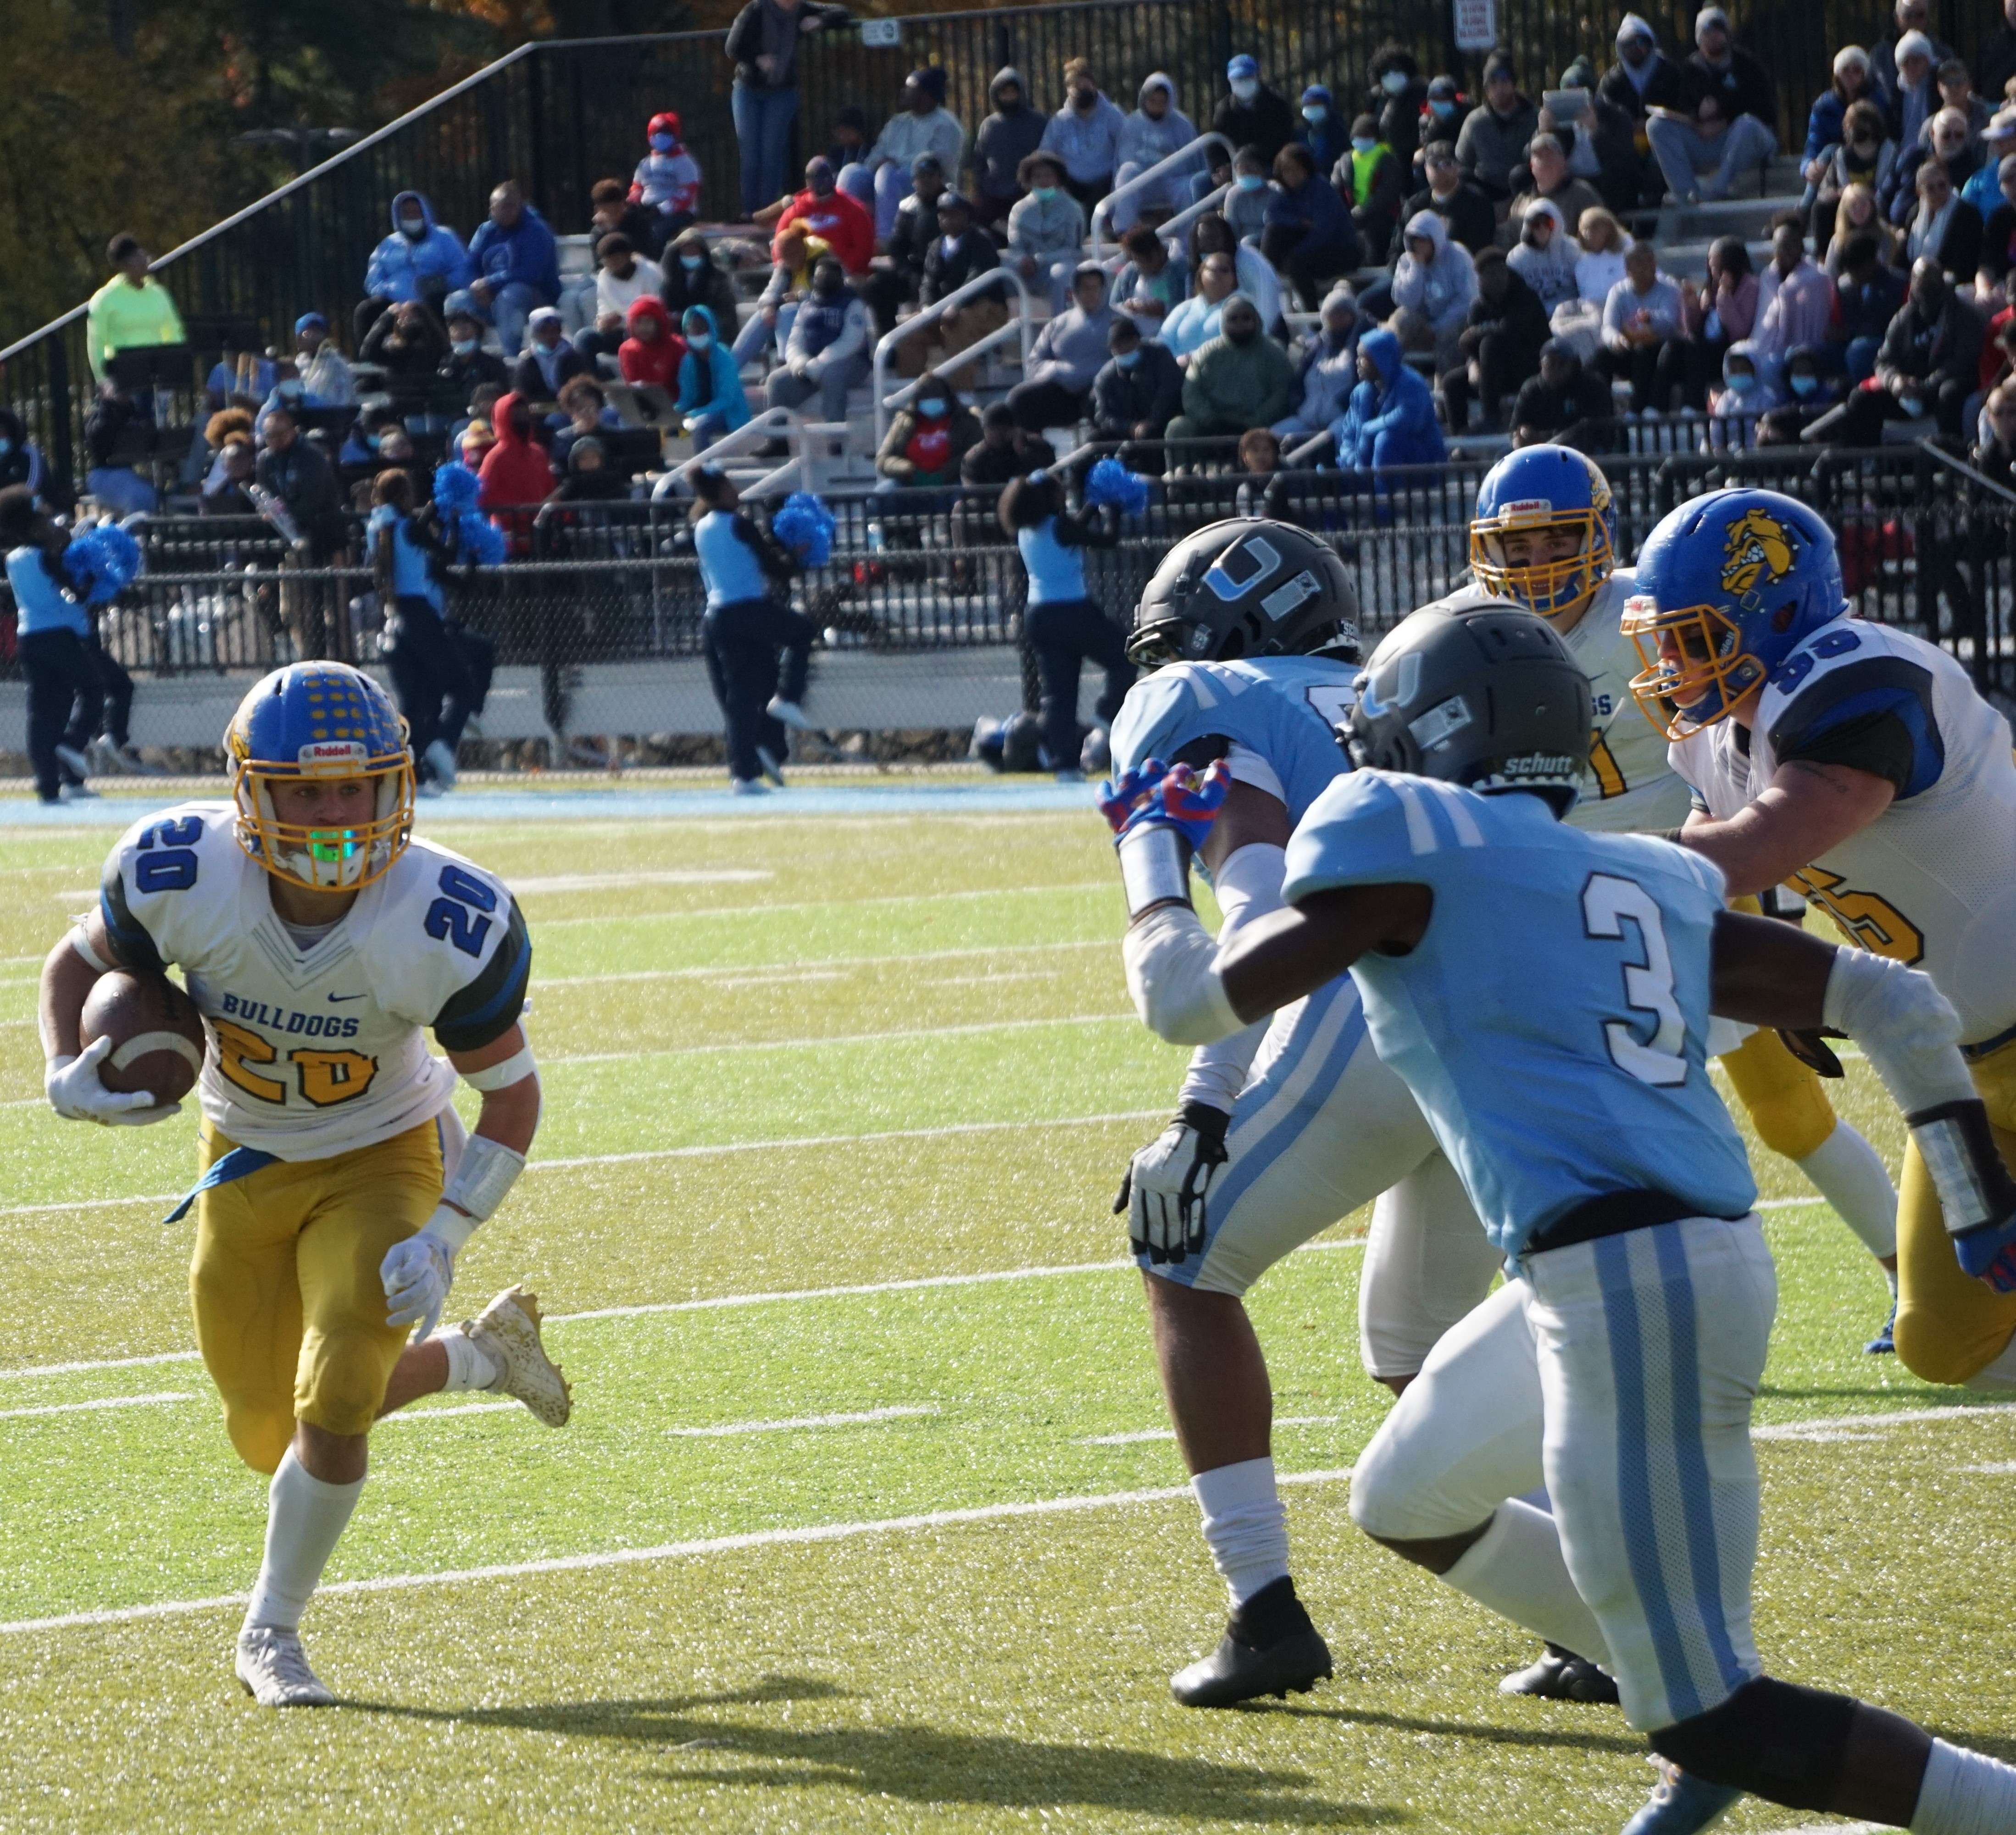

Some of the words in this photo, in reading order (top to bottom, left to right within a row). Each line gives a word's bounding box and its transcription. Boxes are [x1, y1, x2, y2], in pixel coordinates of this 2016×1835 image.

[1511, 500, 1539, 512] Riddell
[314, 744, 351, 756] Riddell
[136, 816, 205, 895] 20
[423, 864, 497, 959] 20
[222, 992, 360, 1038] BULLDOGS
[1579, 870, 1688, 1088] 3
[205, 1016, 379, 1108] 20
